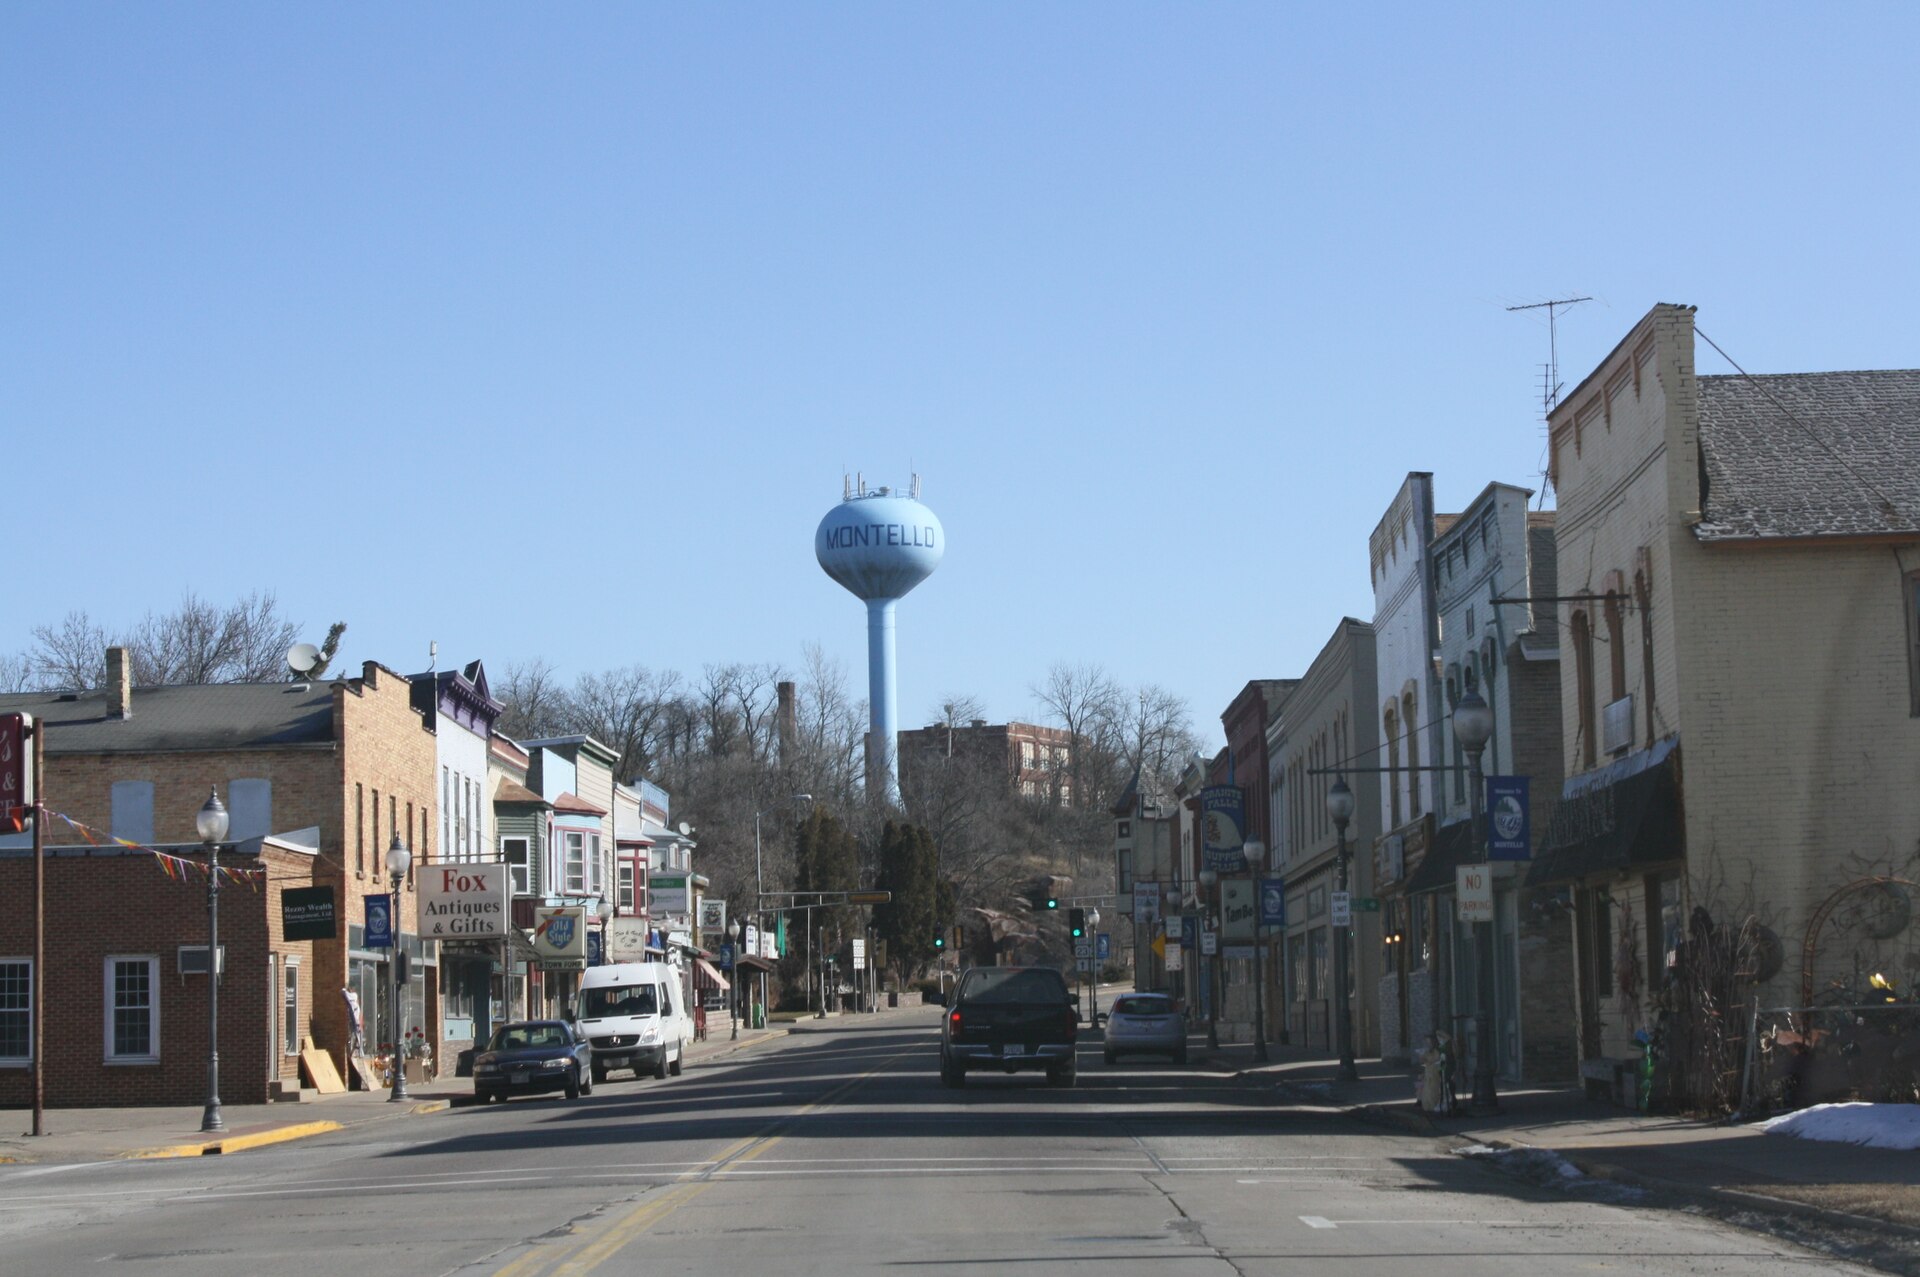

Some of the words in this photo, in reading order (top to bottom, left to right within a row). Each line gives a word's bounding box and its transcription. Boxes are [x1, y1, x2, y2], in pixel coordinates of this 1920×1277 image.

[826, 524, 935, 550] MONTELLO
[3, 772, 15, 791] &
[1203, 788, 1243, 800] GRANITE
[1207, 799, 1239, 810] FALLS
[1494, 841, 1524, 849] MONTELLO
[441, 869, 487, 893] Fox
[1466, 875, 1482, 890] NO
[308, 903, 333, 911] Wealth
[425, 900, 500, 918] Antiques
[1460, 900, 1492, 912] PARKING
[433, 922, 443, 934] &
[450, 918, 494, 934] Gifts
[553, 920, 569, 931] Old
[549, 930, 571, 946] Style
